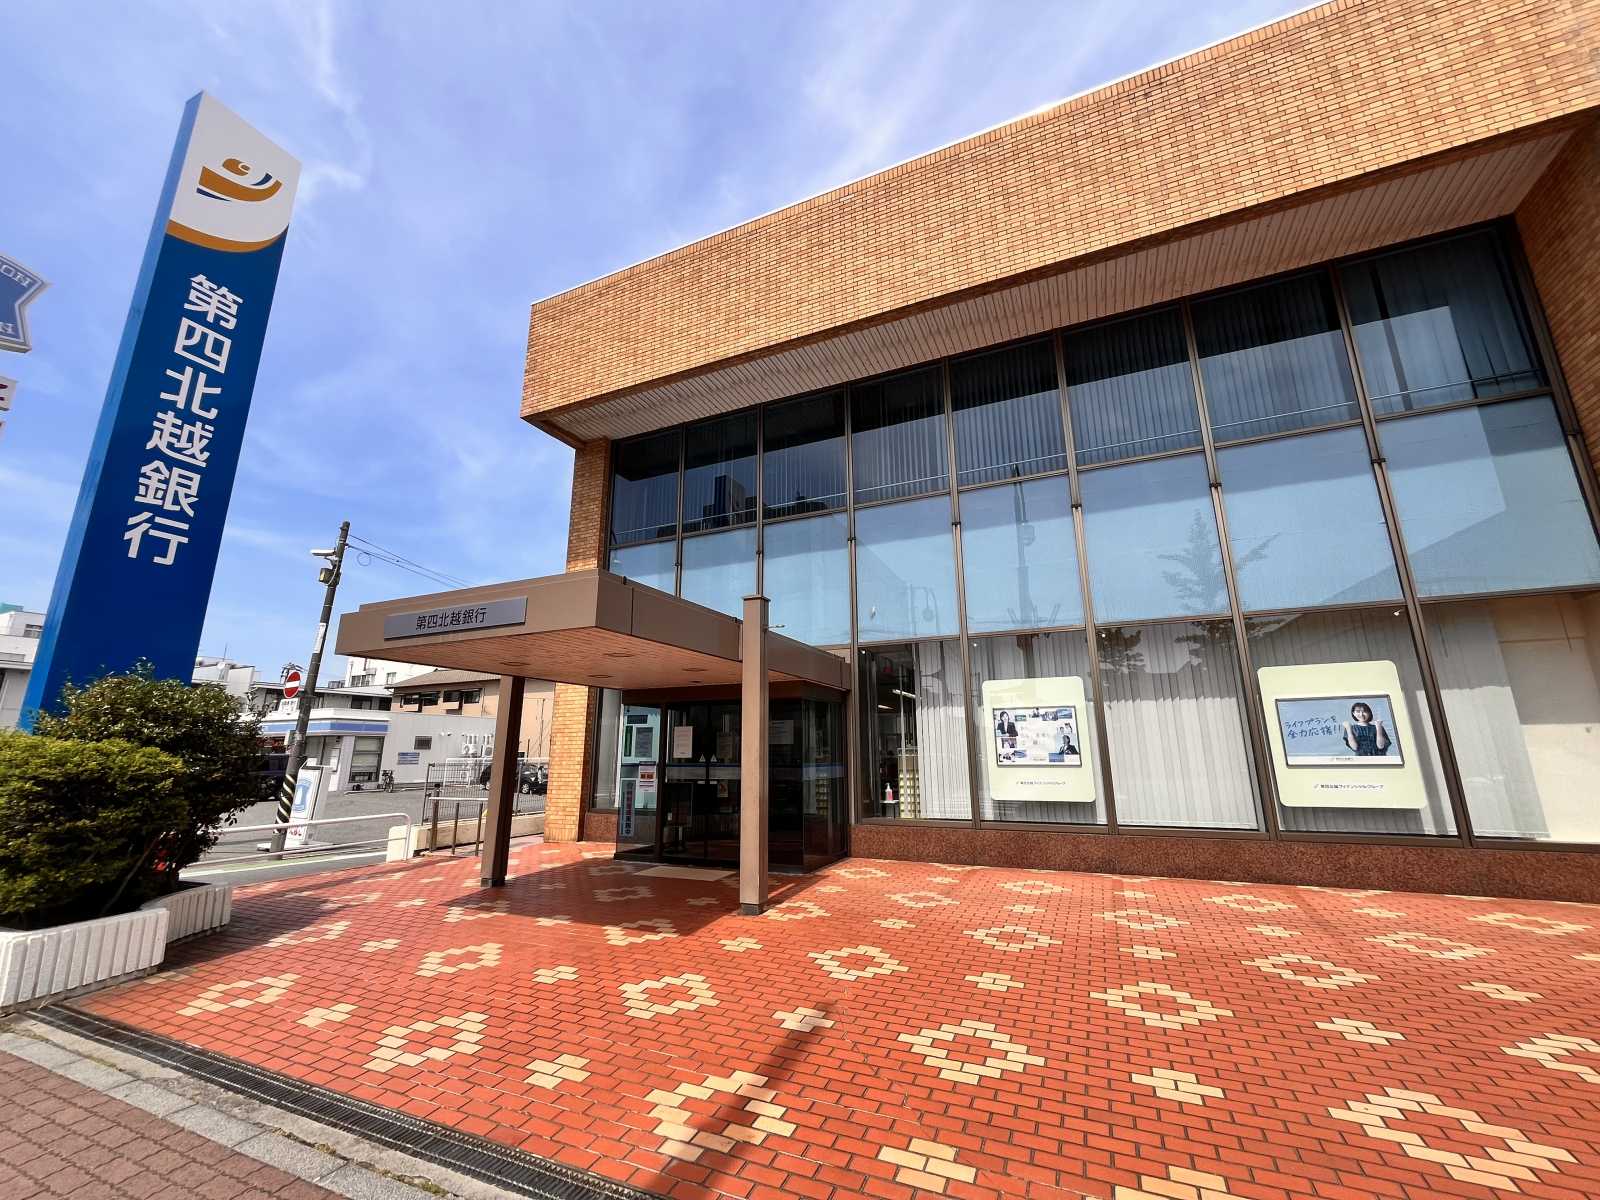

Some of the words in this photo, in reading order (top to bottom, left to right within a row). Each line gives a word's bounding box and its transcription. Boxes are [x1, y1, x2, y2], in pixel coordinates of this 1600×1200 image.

[123, 274, 244, 566] 第四北越銀行
[415, 607, 487, 631] 第四北越銀行
